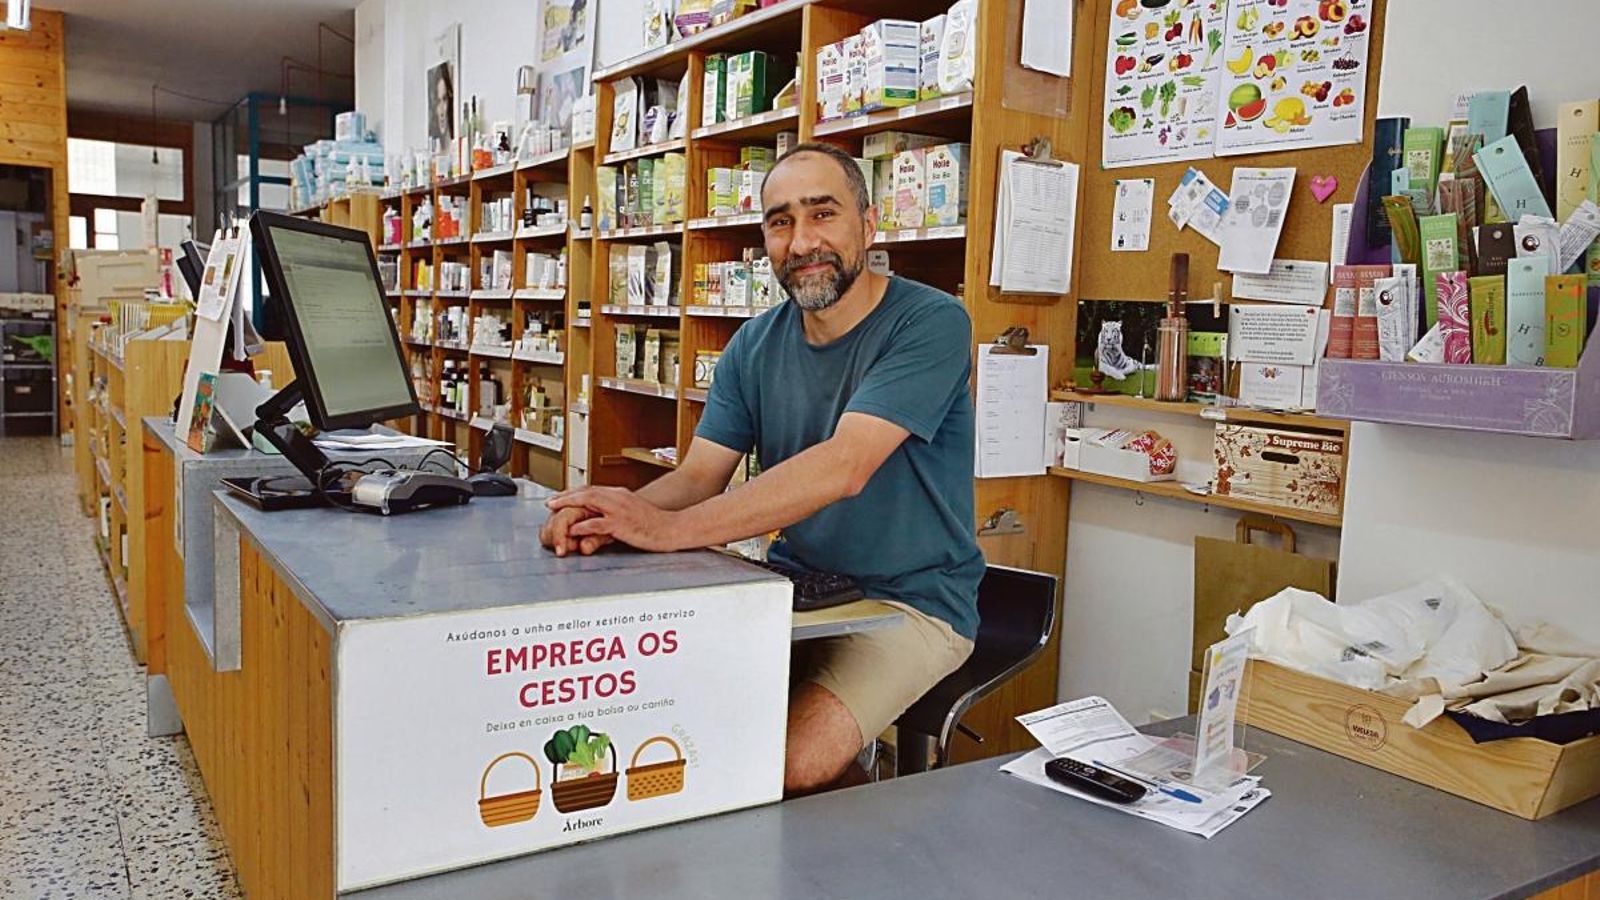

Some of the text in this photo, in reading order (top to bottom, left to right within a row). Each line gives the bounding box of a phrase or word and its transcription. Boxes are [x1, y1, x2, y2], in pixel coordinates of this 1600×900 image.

[1272, 435, 1340, 452] Supreme Bio
[446, 609, 696, 642] Axúdanos a unha mellor xestión do servizo
[487, 630, 678, 675] EMPREGA OS
[519, 670, 636, 708] CESTOS
[485, 698, 675, 732] Deixa en caixa a túa bolsa ou carriño
[563, 817, 603, 832] Árbore
